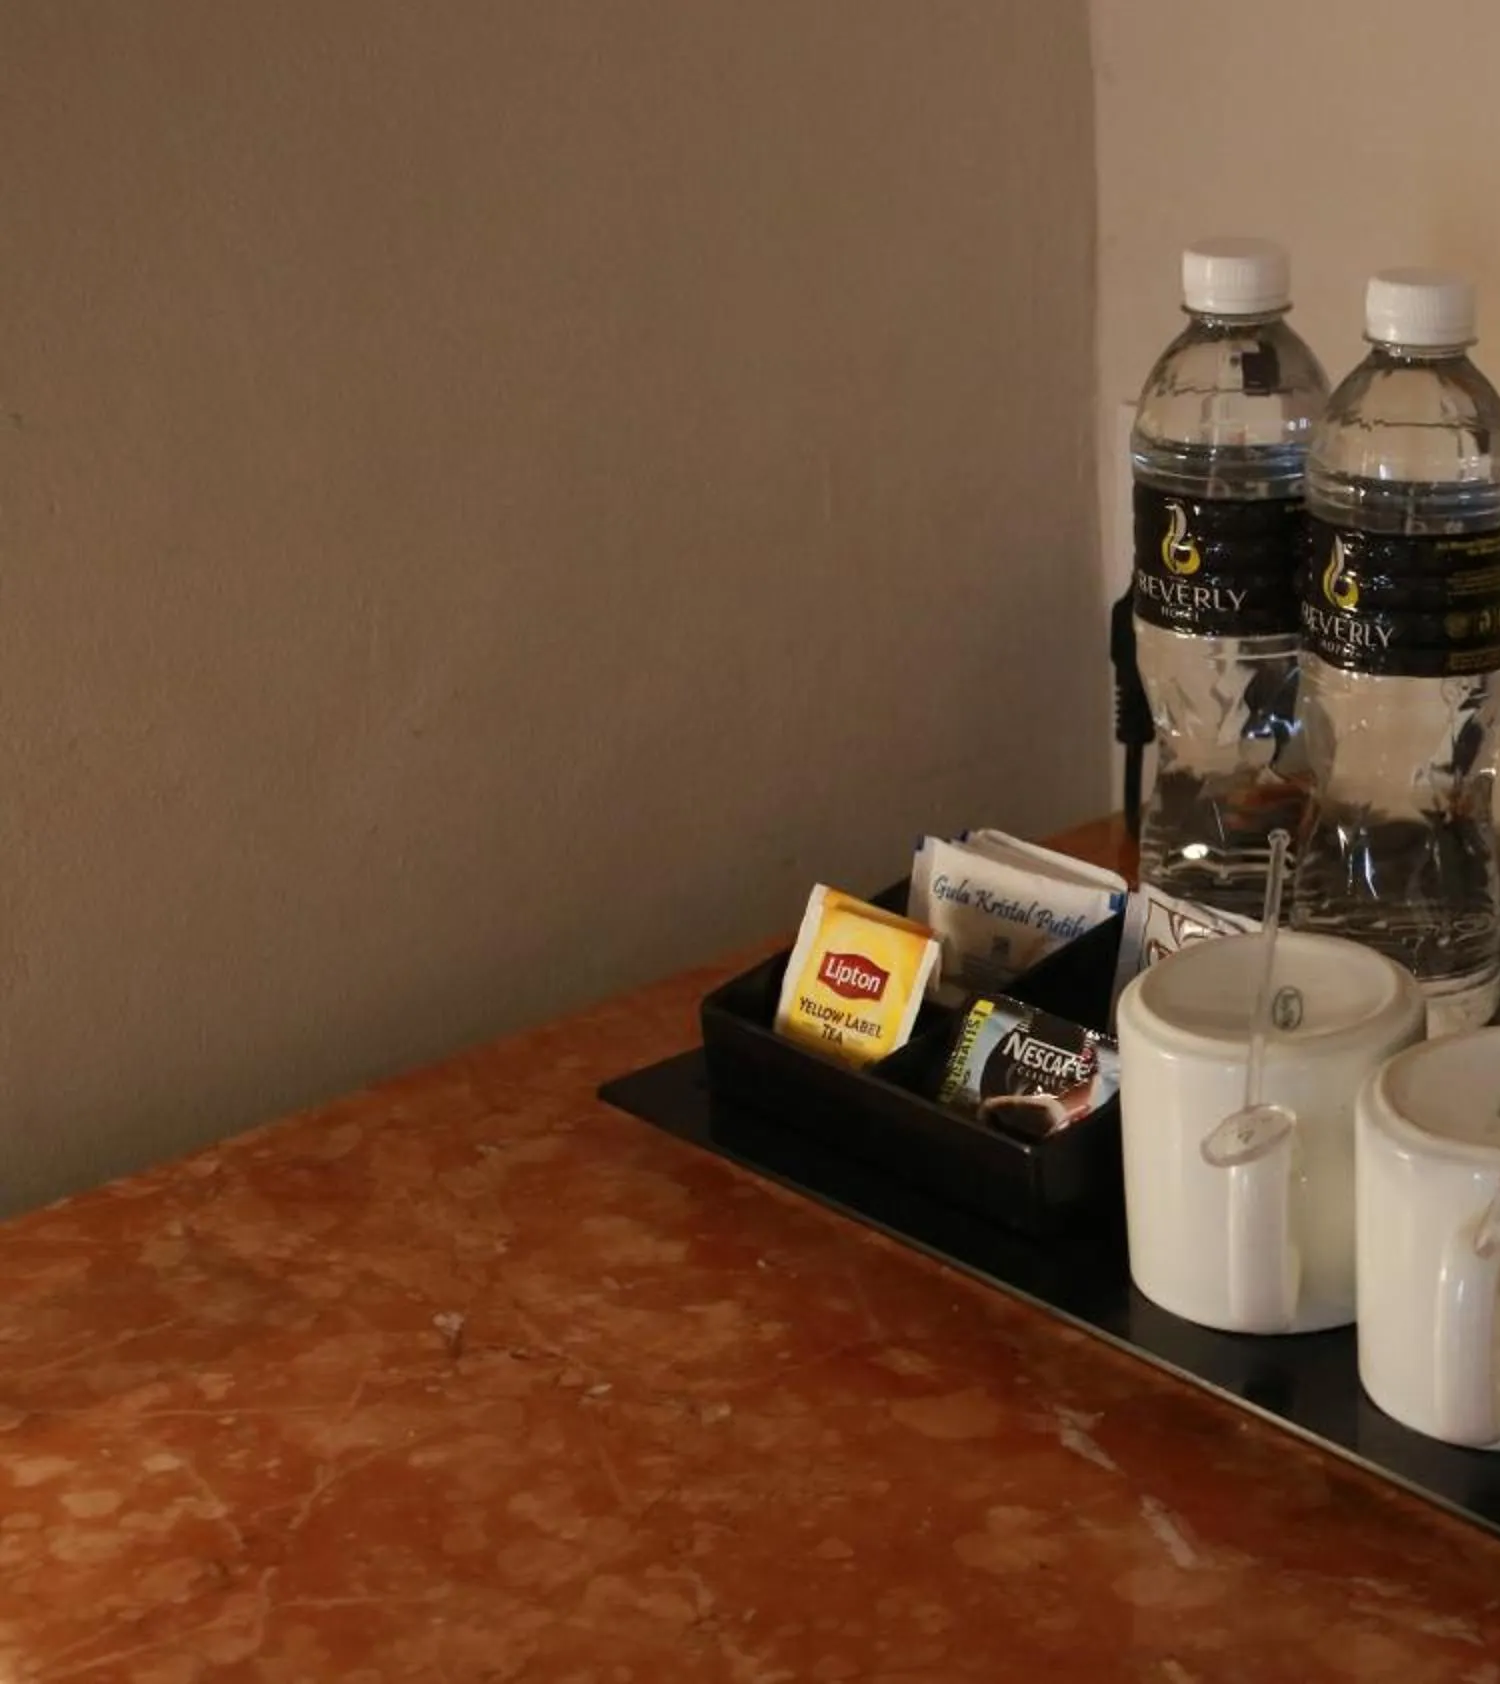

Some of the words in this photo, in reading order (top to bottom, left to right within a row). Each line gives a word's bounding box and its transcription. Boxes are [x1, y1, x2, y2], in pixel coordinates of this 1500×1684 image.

[1138, 574, 1248, 612] BEVERLY
[1301, 602, 1395, 648] BEVERLY
[932, 874, 971, 904] Gula
[975, 889, 1038, 925] Kristal
[1036, 909, 1086, 938] Putih
[825, 956, 881, 993] Lipton
[799, 995, 845, 1025] YELLOW
[845, 1013, 883, 1039] LABEL
[821, 1023, 844, 1045] TEA
